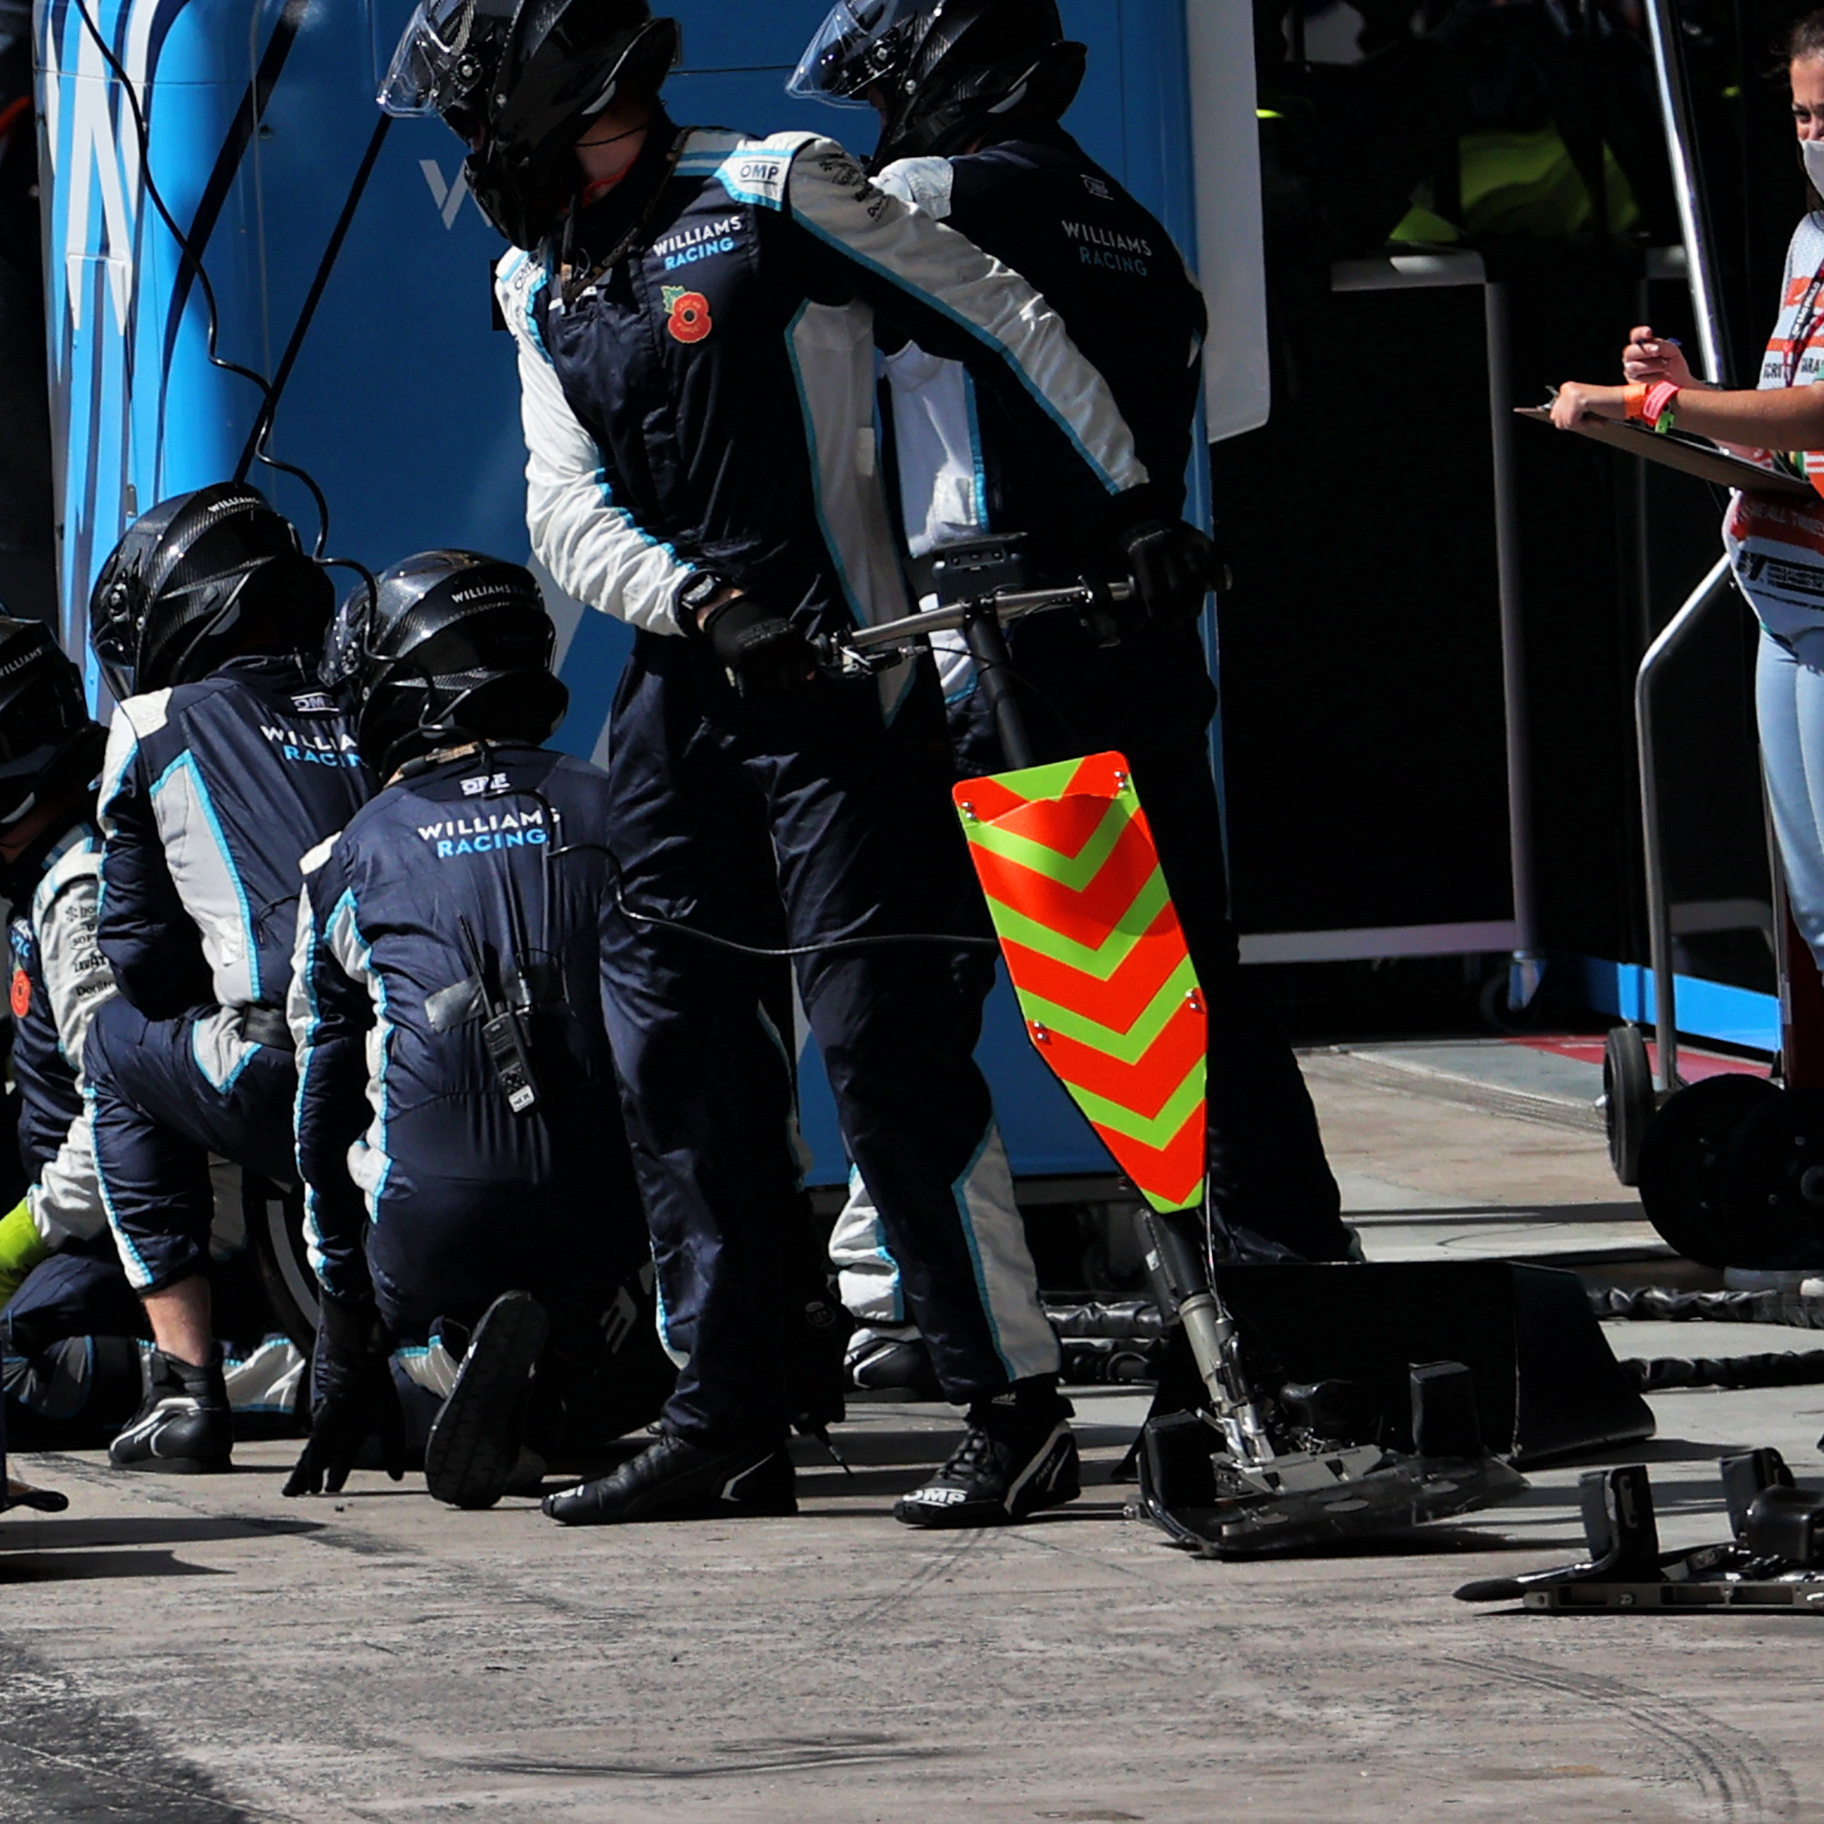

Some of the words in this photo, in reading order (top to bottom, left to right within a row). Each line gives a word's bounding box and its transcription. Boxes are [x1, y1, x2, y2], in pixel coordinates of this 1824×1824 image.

[739, 161, 780, 182] OMP
[652, 215, 743, 258] WILLIAMS
[1061, 219, 1153, 258] WILLIAMS
[664, 236, 735, 272] RACING
[1079, 246, 1149, 278] RACING
[451, 583, 511, 604] WILLIAMS
[418, 808, 561, 841] WILLIAMS
[436, 827, 547, 859] RACING
